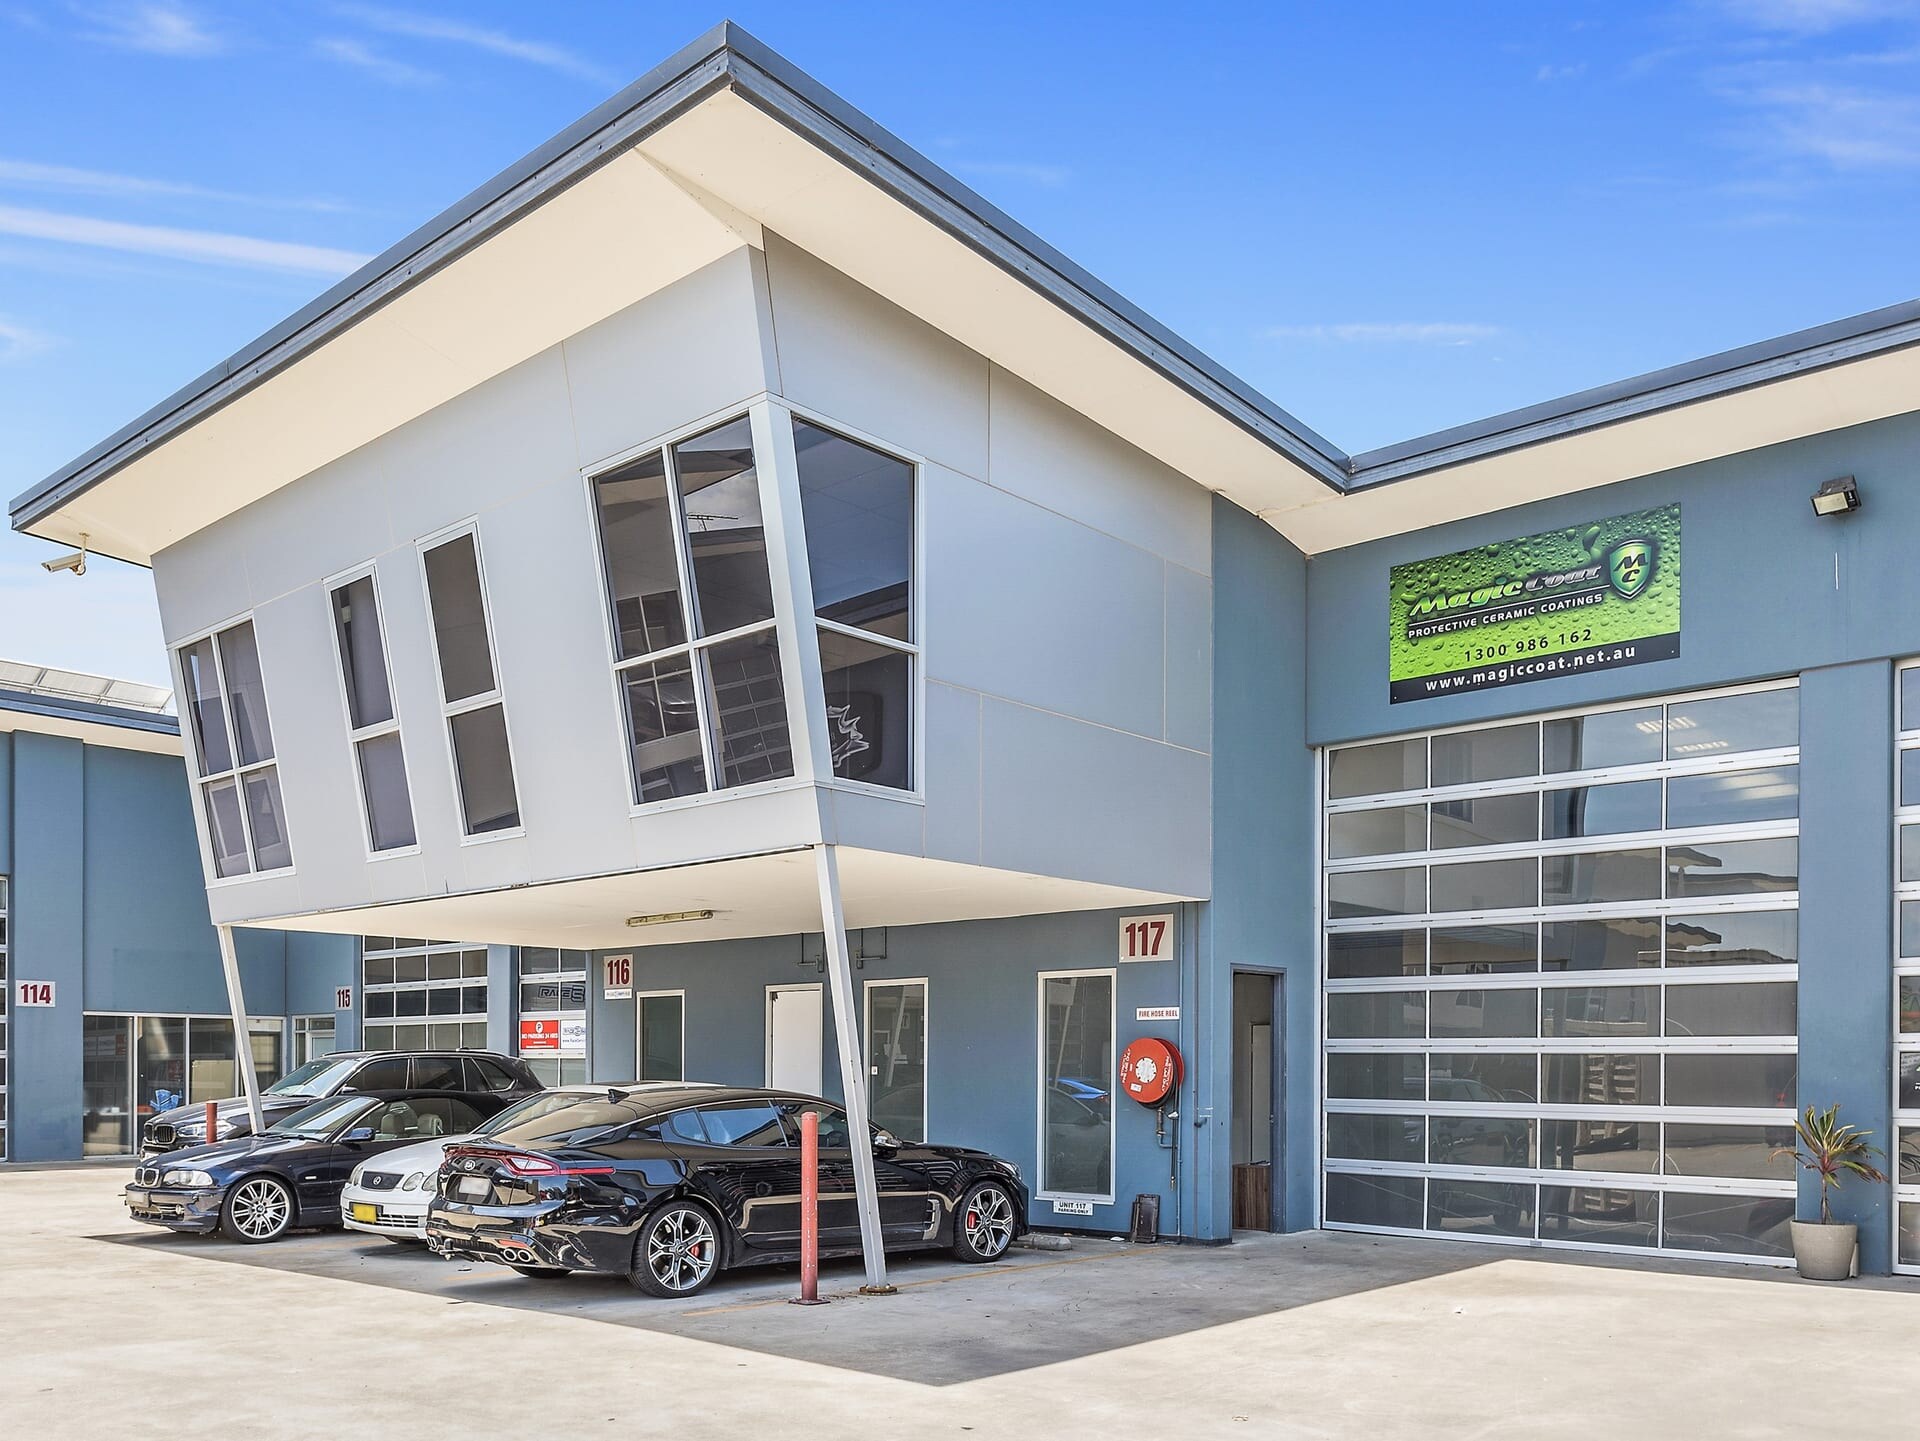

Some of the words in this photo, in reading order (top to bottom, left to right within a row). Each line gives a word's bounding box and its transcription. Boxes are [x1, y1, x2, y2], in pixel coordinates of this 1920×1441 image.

[1409, 576, 1523, 616] Magic
[1408, 617, 1477, 639] PROTECTIVE
[1482, 606, 1535, 624] CERAMIC
[1540, 593, 1603, 613] COATINGS
[1464, 644, 1507, 662] 1300
[1515, 636, 1549, 653] 986
[1558, 629, 1592, 645] 162
[1425, 646, 1635, 691] www.magiccoat.net.au
[1125, 921, 1166, 957] 117
[607, 958, 630, 985] 116
[20, 983, 52, 1004] 114
[336, 988, 351, 1008] 115
[1138, 1010, 1150, 1018] FIRE
[1165, 1009, 1178, 1017] REEL
